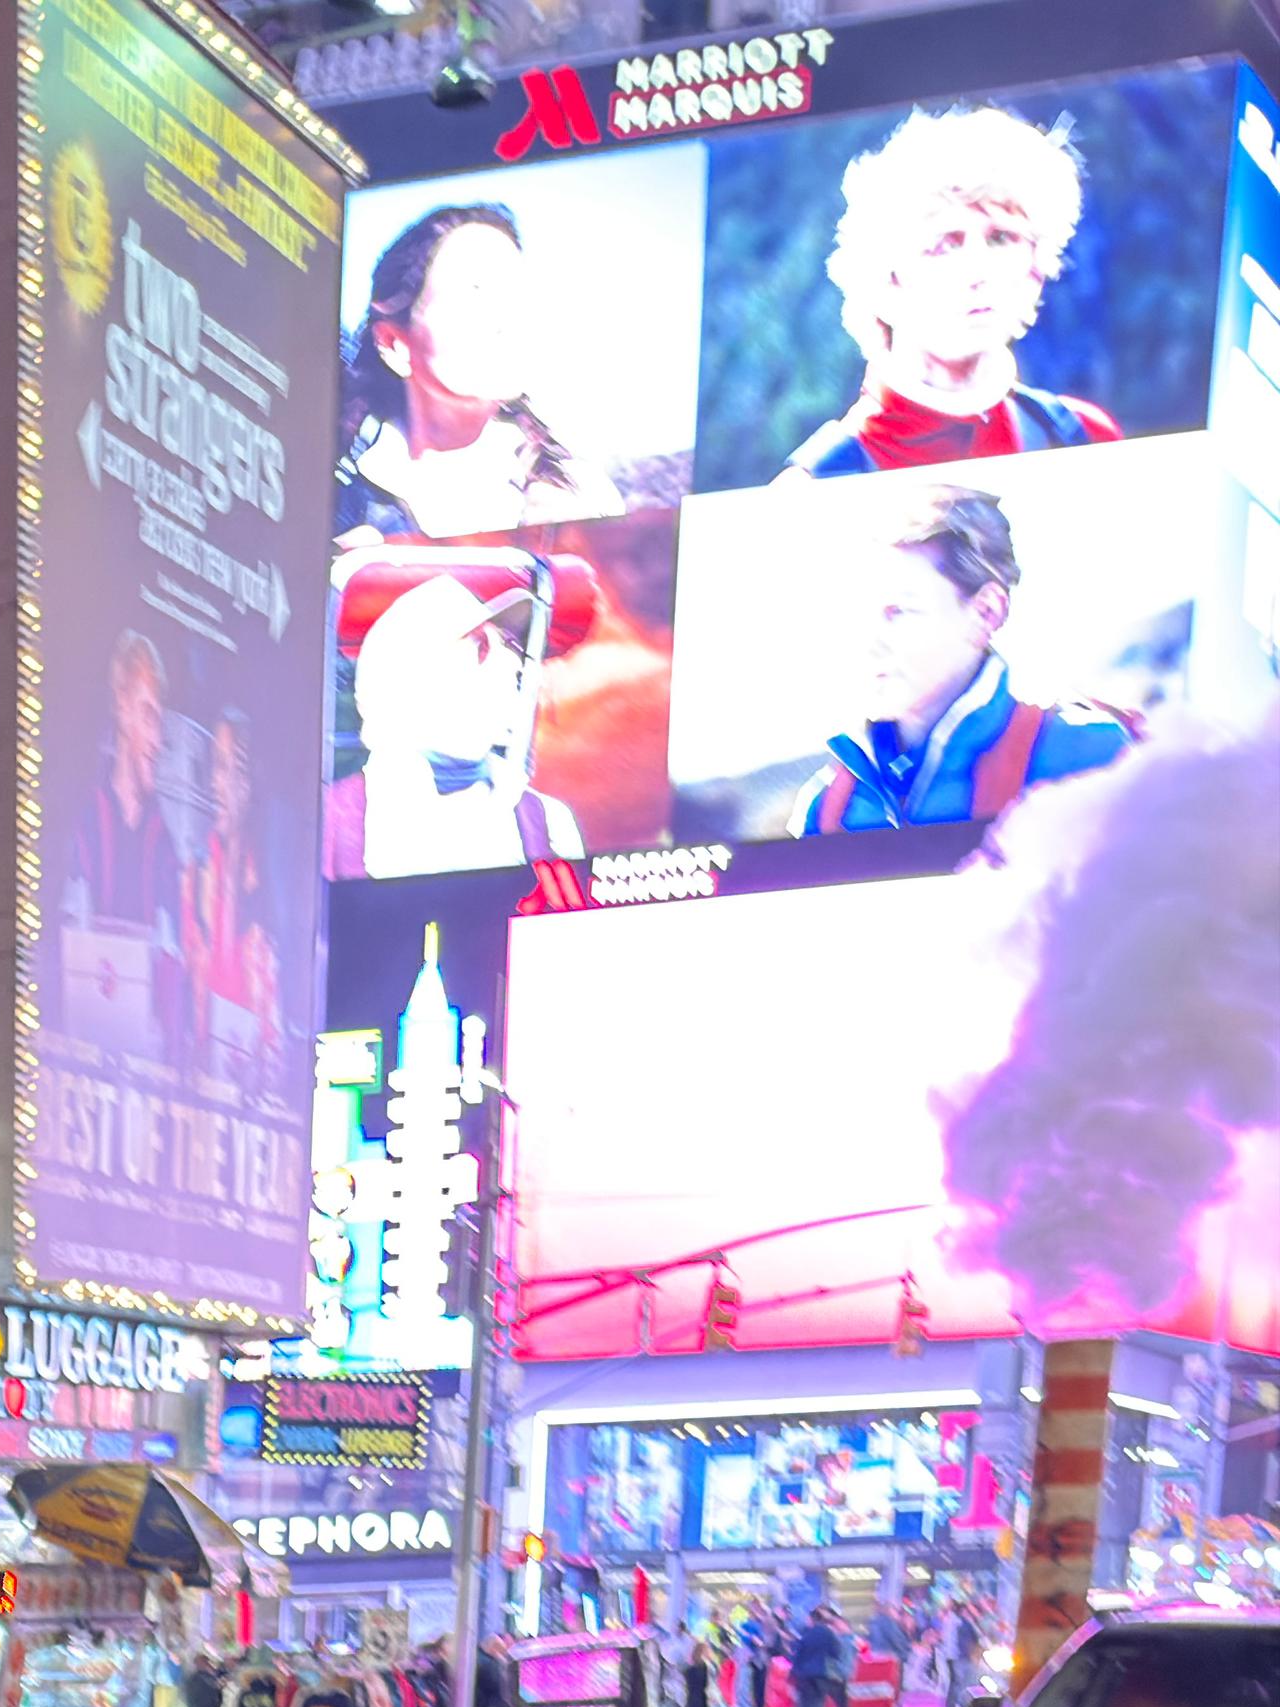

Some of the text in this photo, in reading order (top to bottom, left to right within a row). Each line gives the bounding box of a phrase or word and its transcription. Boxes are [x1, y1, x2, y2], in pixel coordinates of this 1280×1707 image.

[616, 28, 834, 94] MARRIOTT
[614, 72, 804, 133] MARQUIS
[3, 1304, 192, 1393] LUGGAGE
